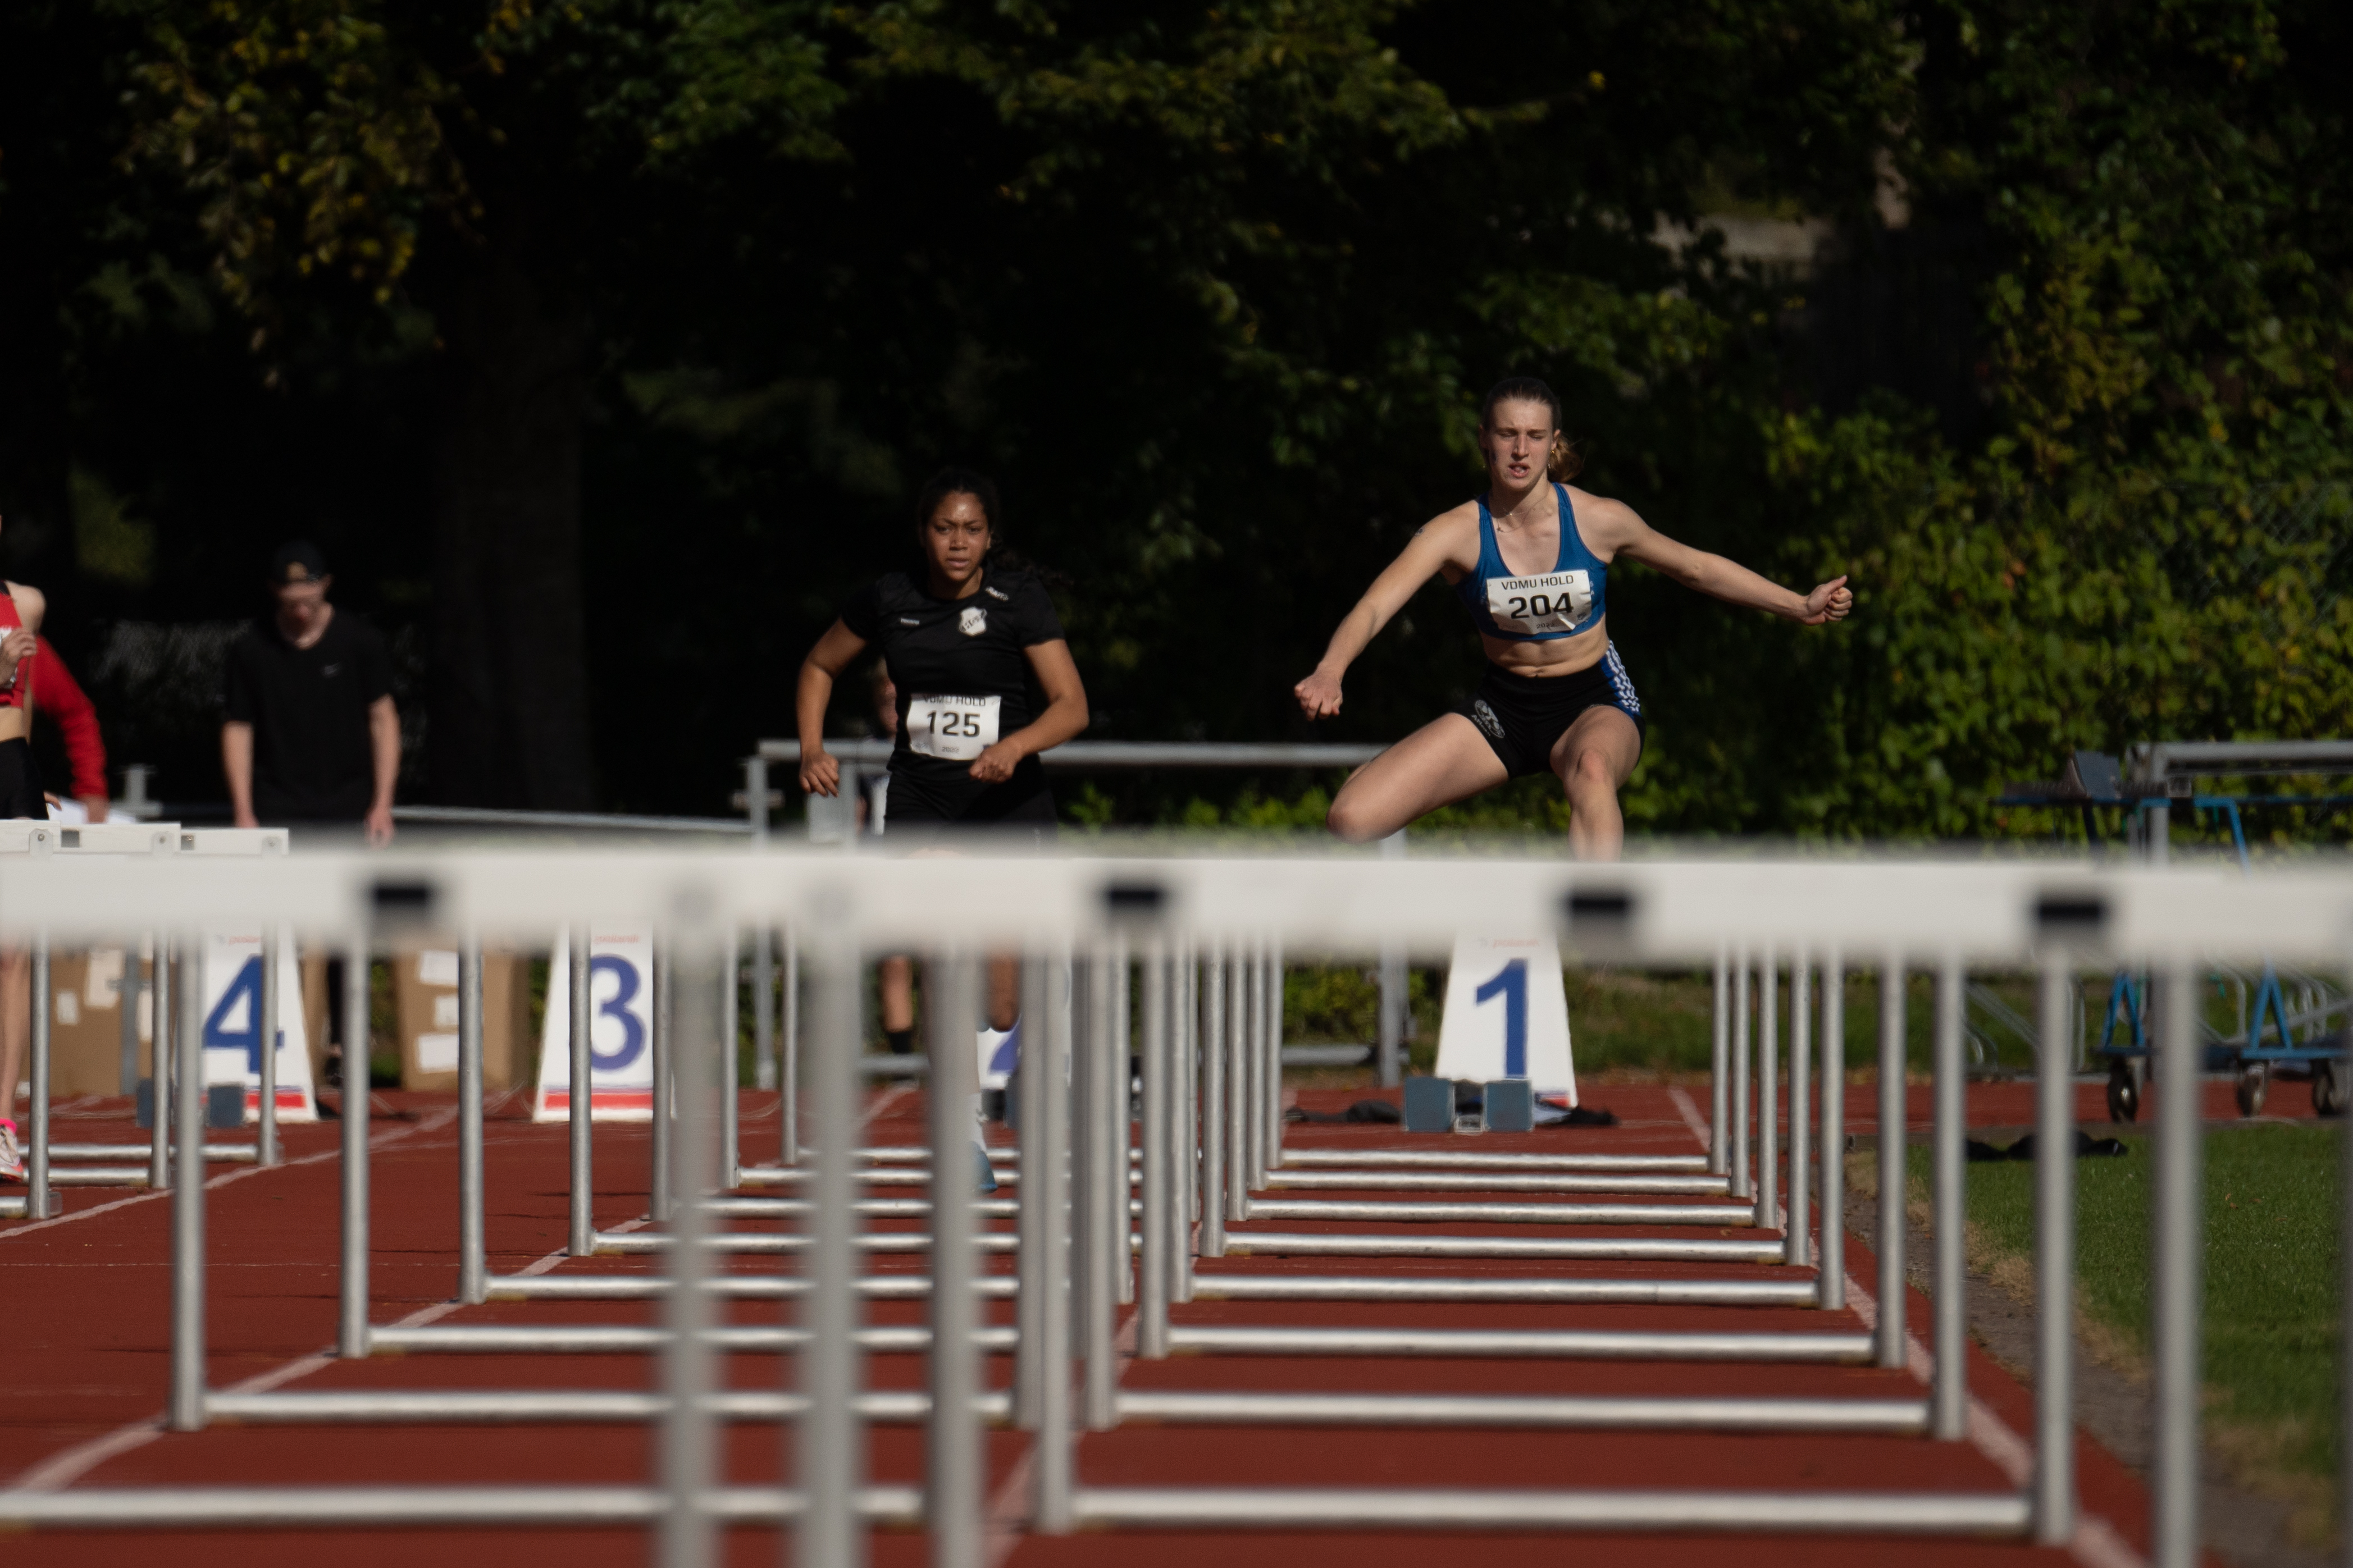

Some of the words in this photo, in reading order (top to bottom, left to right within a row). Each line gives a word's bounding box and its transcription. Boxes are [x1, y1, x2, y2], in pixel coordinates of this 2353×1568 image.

[1501, 579, 1537, 590] VDMU
[1541, 575, 1574, 587] HOLD
[1508, 592, 1574, 619] 204
[927, 710, 981, 737] 125
[201, 953, 285, 1073] 4
[591, 953, 646, 1073] 3
[1474, 958, 1528, 1079] 1
